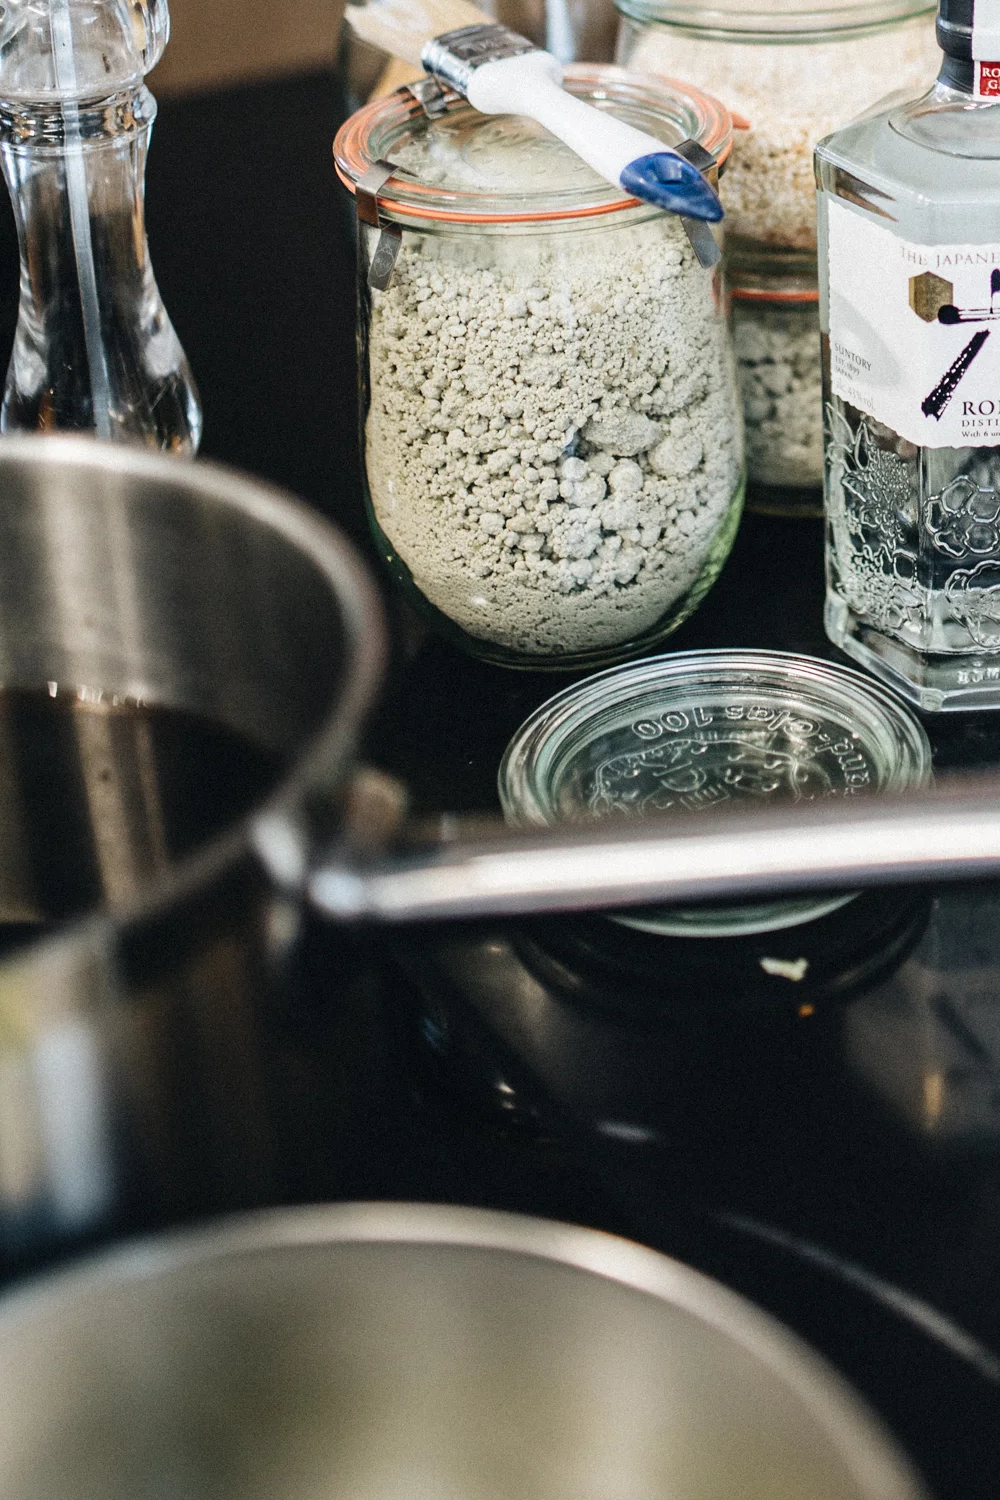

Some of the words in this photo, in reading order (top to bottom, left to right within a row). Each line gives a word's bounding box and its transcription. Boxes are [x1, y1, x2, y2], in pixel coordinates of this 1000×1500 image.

[900, 245, 928, 266] THE
[834, 342, 872, 372] SUNTORY
[961, 429, 981, 438] With
[631, 706, 713, 741] 100
